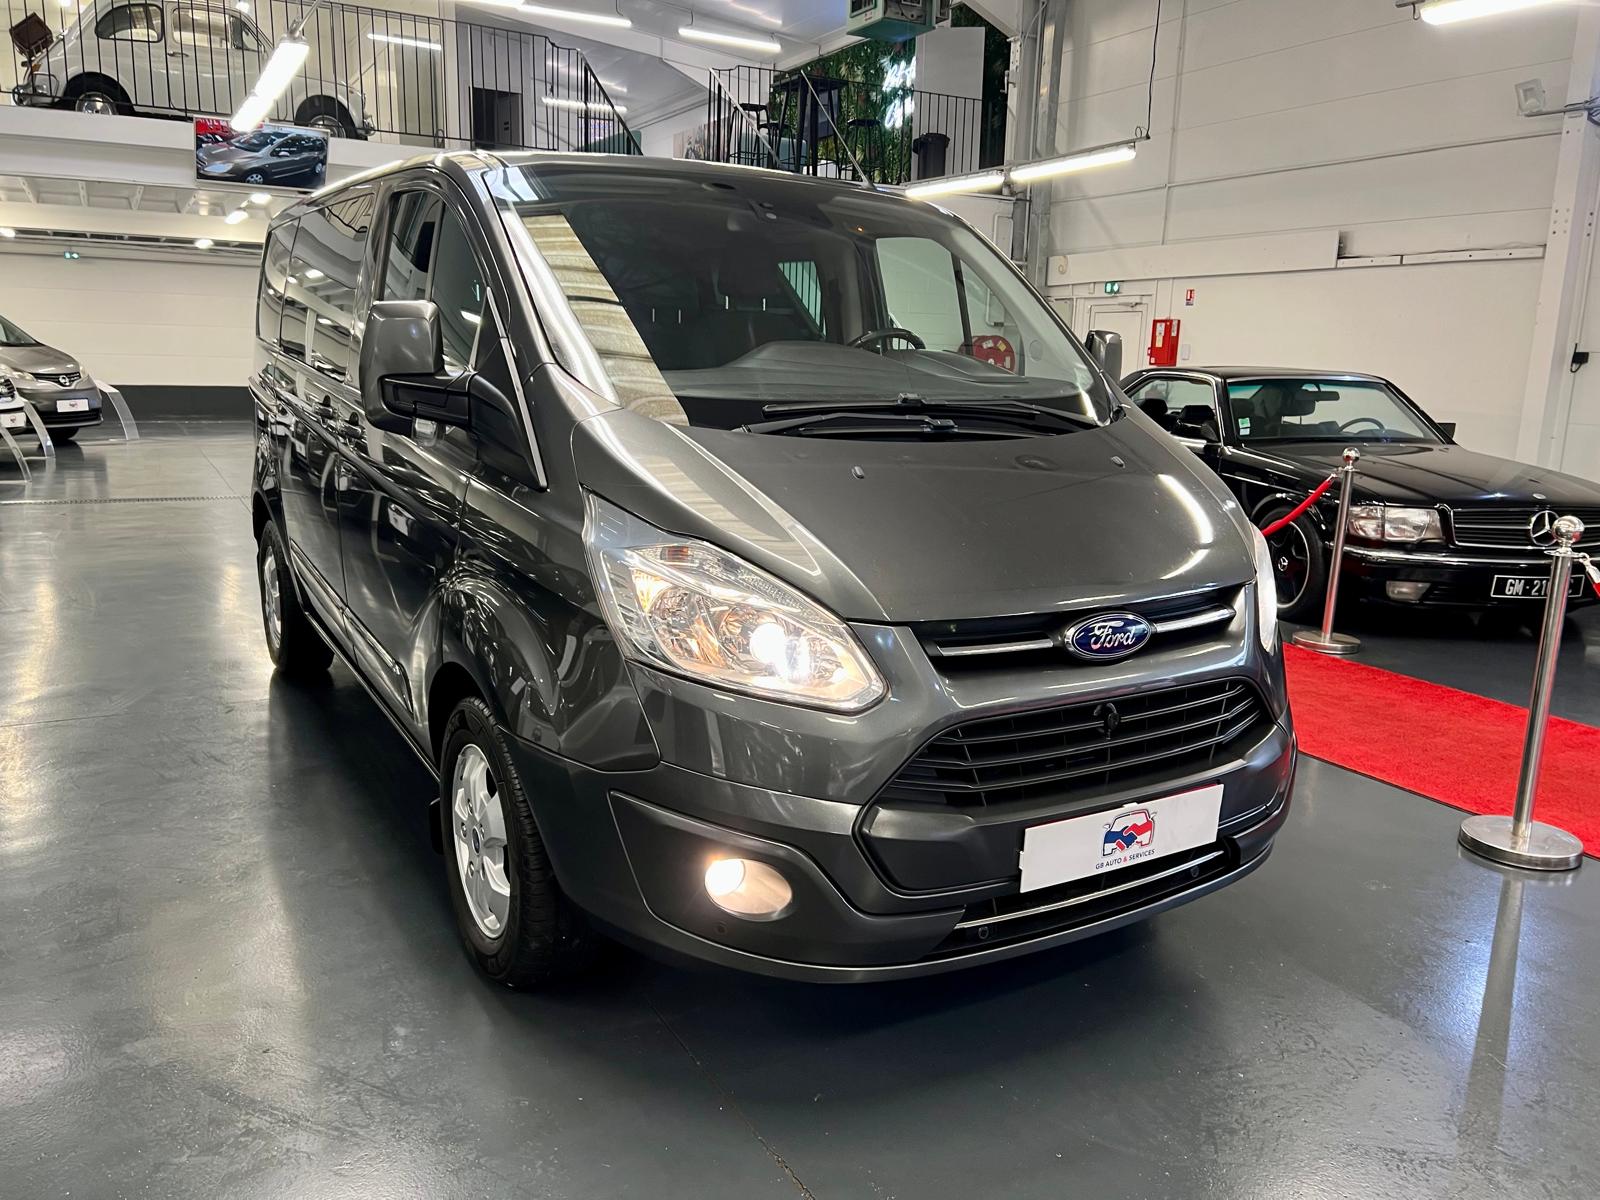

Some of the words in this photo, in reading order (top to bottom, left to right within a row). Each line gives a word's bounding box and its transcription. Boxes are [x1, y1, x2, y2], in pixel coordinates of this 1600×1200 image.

[1088, 620, 1136, 650] Ford
[1095, 862, 1105, 870] GB
[1105, 857, 1122, 867] AUTO
[1129, 849, 1155, 861] SERVICES
